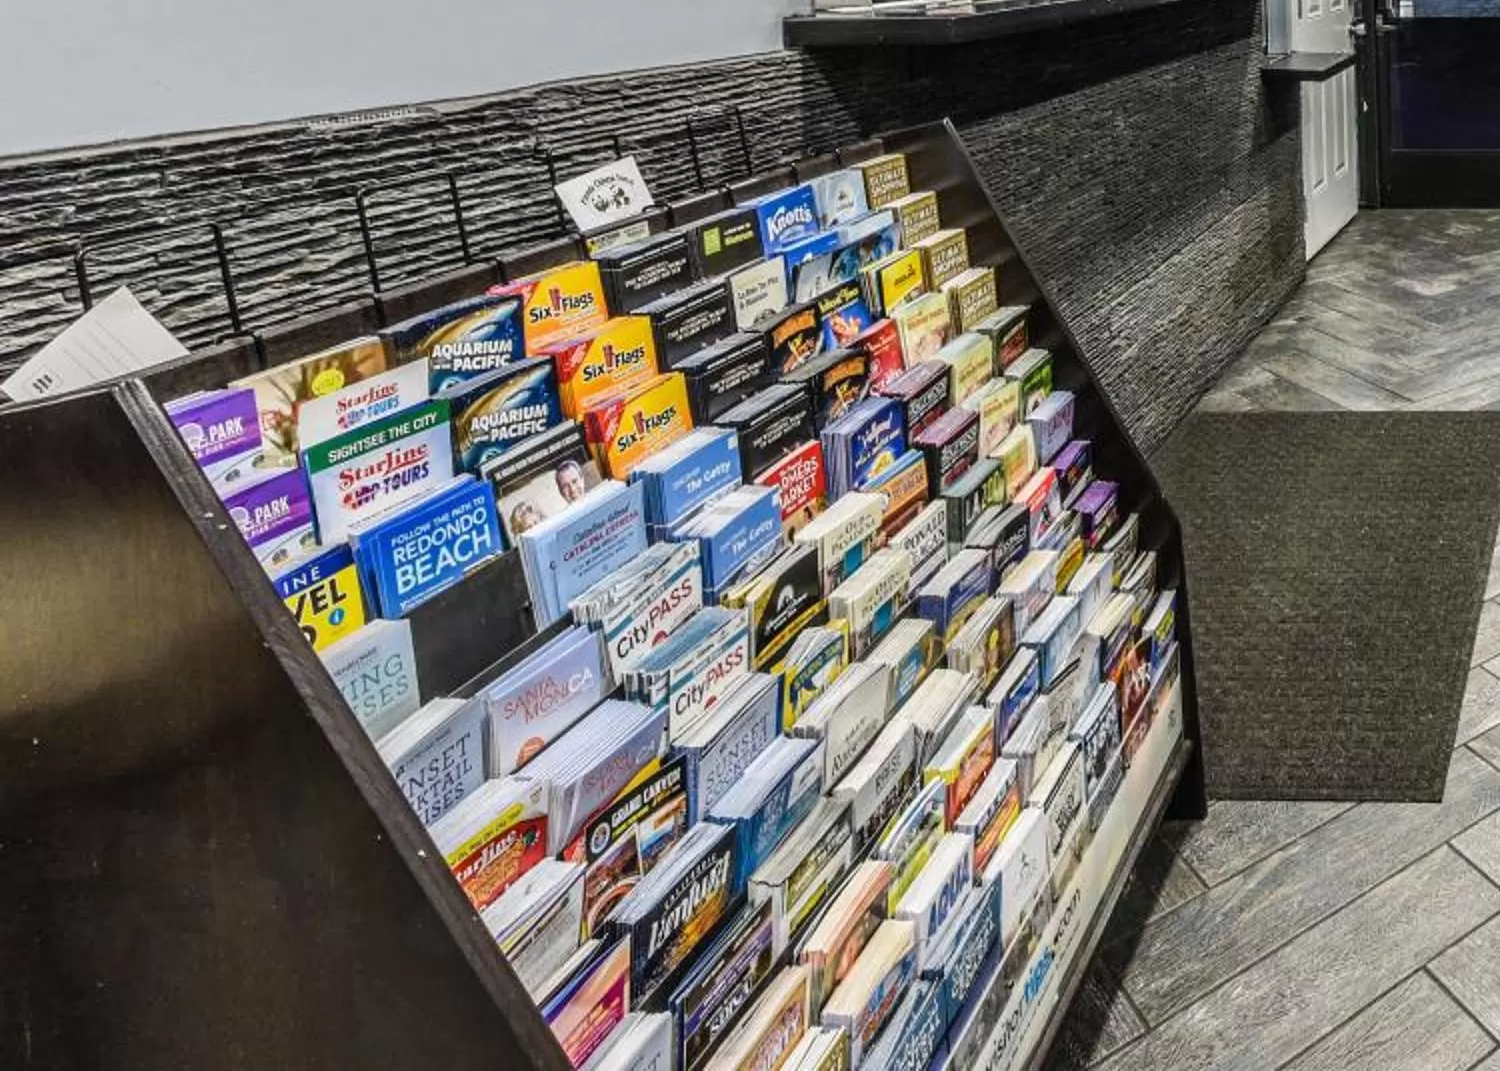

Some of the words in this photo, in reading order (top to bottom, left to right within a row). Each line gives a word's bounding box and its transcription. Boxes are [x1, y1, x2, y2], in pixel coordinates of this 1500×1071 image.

[768, 203, 813, 242] Knott's
[529, 306, 552, 323] Six
[562, 292, 594, 312] Flags
[432, 340, 512, 360] AQUARIUM
[453, 354, 510, 371] PACIFIC
[583, 364, 605, 381] Six
[615, 346, 645, 366] Flags
[336, 382, 399, 414] Starline
[367, 395, 400, 418] TOURS
[470, 404, 547, 430] AQUARIUM
[209, 417, 244, 442] PARK
[328, 431, 388, 463] SIGHTSEE
[388, 420, 411, 441] THE
[413, 412, 438, 430] CITY
[491, 419, 547, 441] PACIFIC
[617, 434, 638, 453] Six
[339, 444, 429, 491] Starline
[383, 461, 430, 494] TOURS
[253, 495, 290, 524] PARK
[392, 522, 431, 548] FOLLOW
[433, 512, 449, 525] THE
[451, 501, 473, 518] PATH
[472, 496, 485, 507] TO
[393, 507, 487, 566] REDONDO
[396, 524, 491, 596] BEACH
[616, 578, 693, 659] CityPASS
[346, 654, 403, 700] ING
[359, 674, 409, 718] SES
[503, 676, 556, 720] SANTA
[523, 666, 594, 724] MONICA
[675, 645, 744, 716] CityPASS
[405, 732, 471, 797] NSET
[413, 759, 473, 811] KTAIL
[456, 830, 517, 883] tarline
